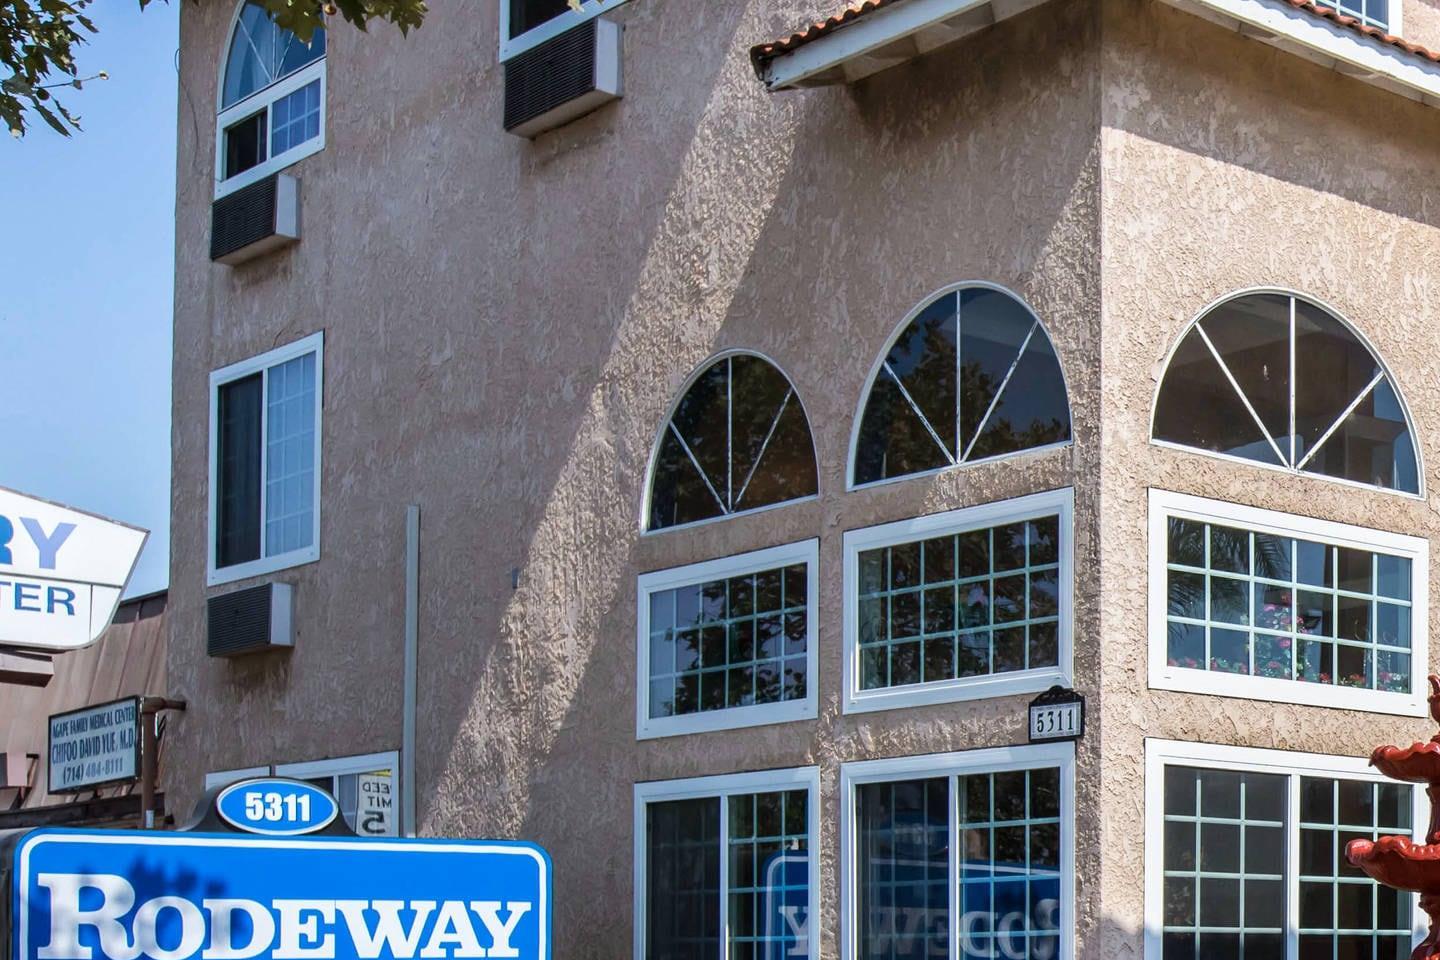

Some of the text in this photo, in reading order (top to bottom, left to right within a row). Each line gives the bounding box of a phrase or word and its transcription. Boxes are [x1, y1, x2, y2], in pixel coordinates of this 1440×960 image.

[53, 705, 135, 738] AGAPE FAMILY MEDICAL CENTER
[1037, 709, 1073, 733] 5311
[52, 740, 78, 765] CHIFOO
[80, 736, 100, 758] DAVID
[63, 763, 84, 784] (714)
[245, 791, 311, 822] 5311
